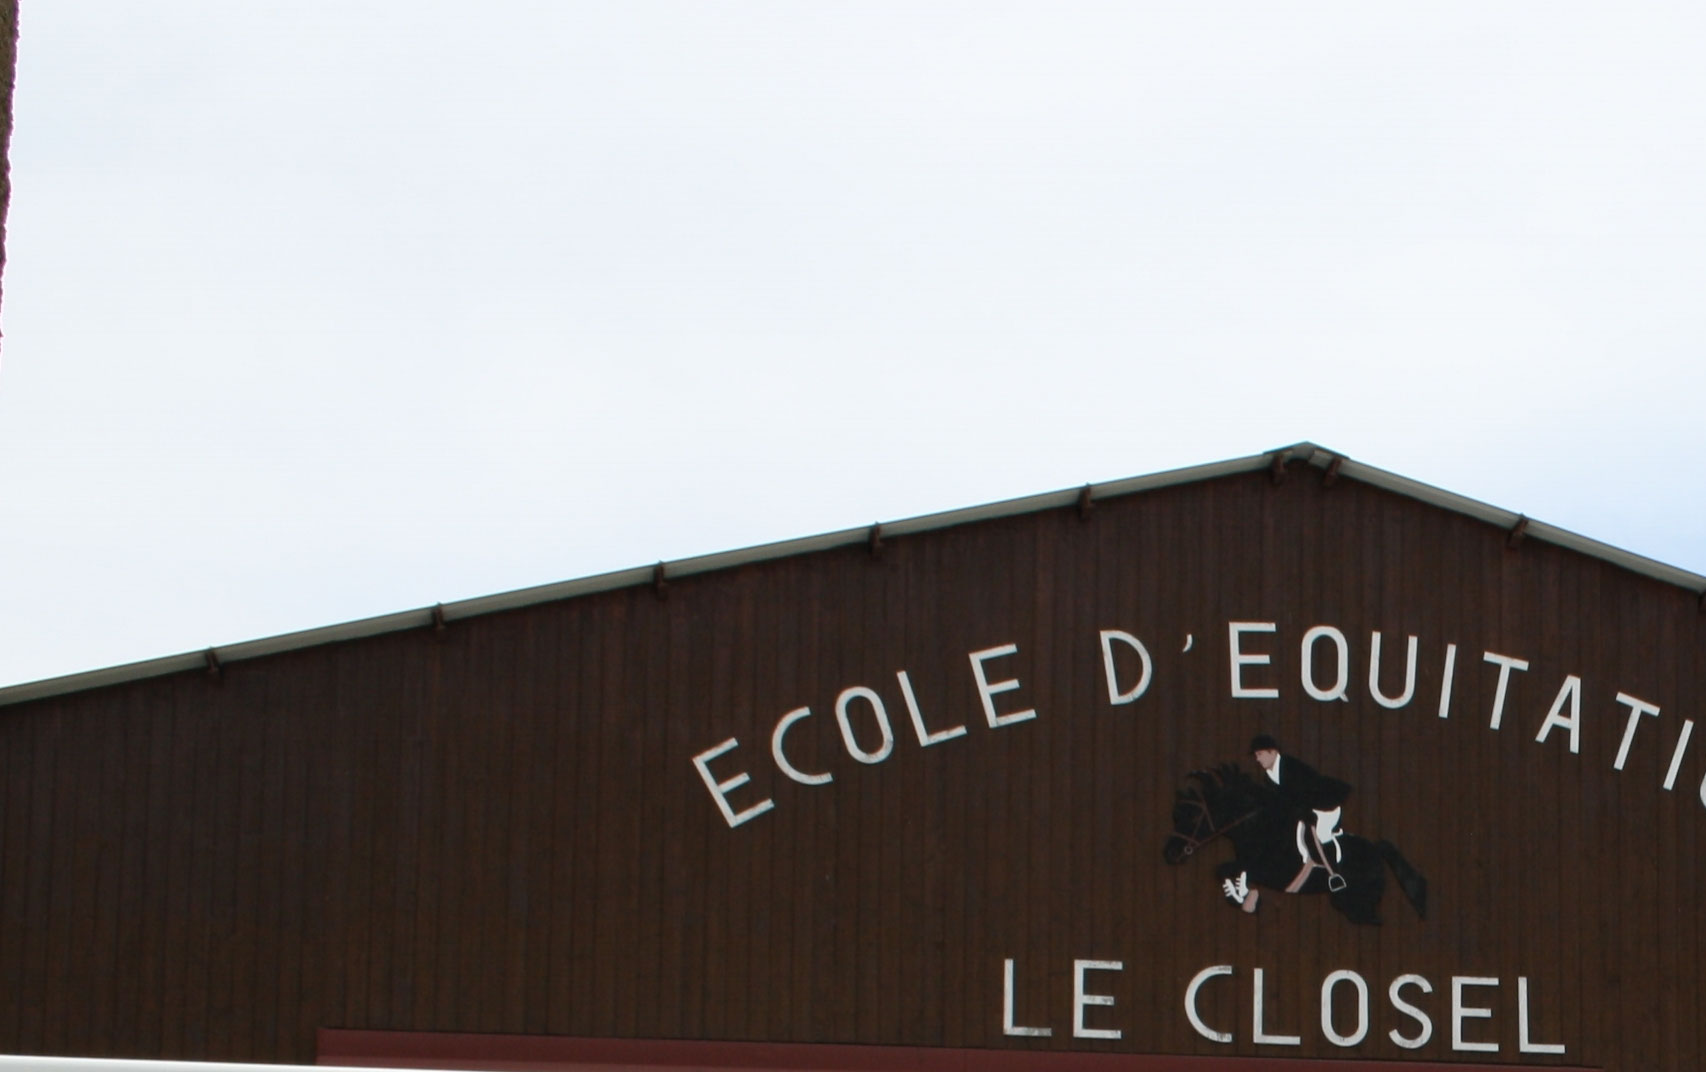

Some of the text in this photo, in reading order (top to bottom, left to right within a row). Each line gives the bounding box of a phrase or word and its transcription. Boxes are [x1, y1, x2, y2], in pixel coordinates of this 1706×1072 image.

[692, 643, 1037, 828] ECOLE
[1003, 959, 1566, 1054] LE CLOSEL
